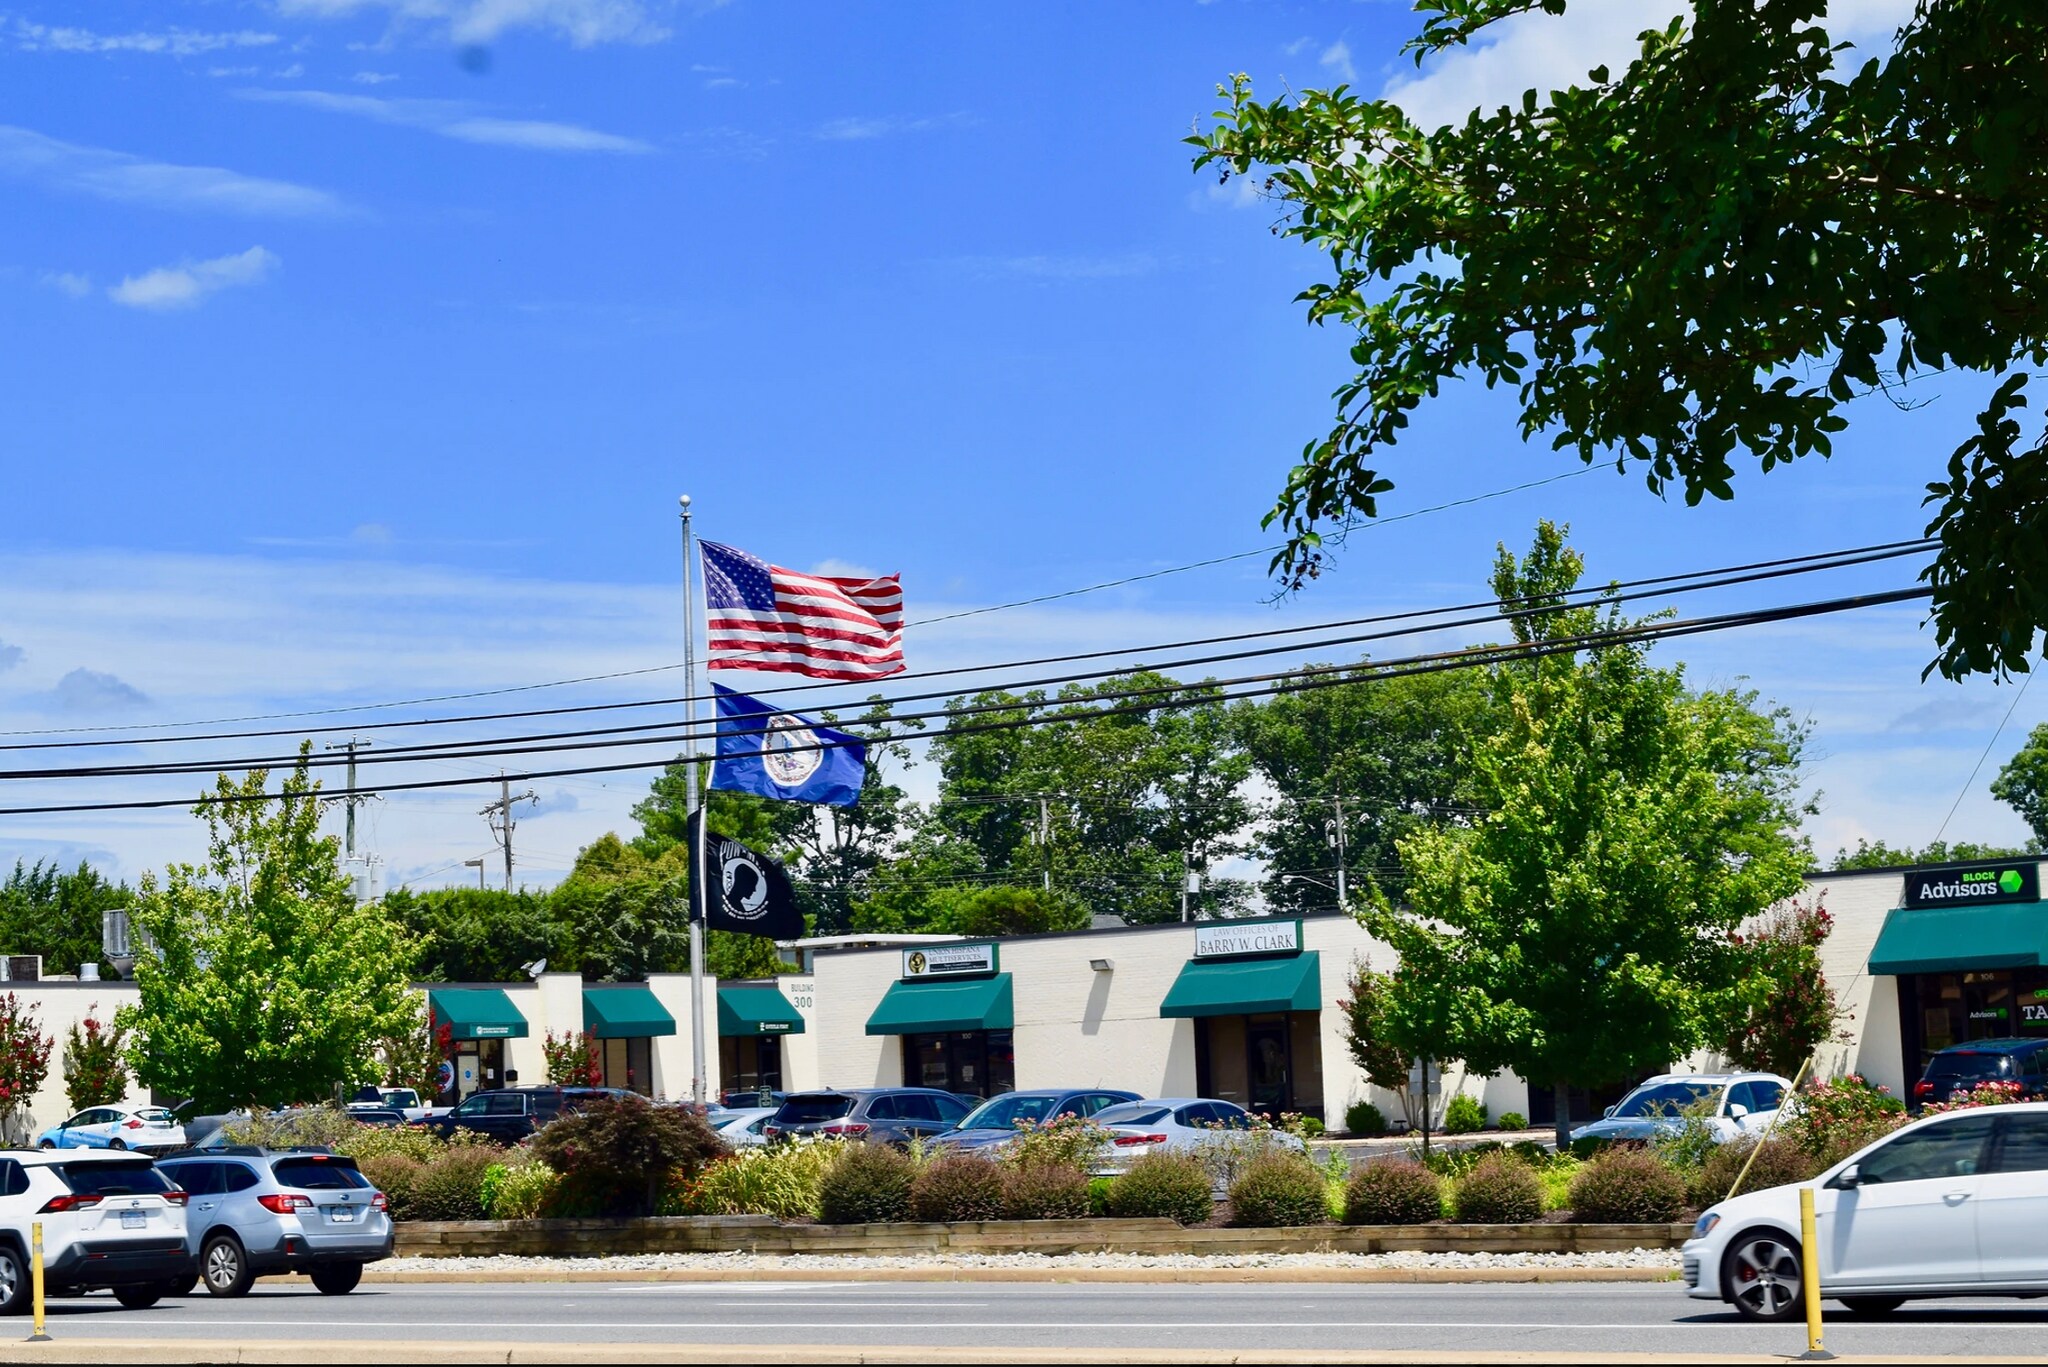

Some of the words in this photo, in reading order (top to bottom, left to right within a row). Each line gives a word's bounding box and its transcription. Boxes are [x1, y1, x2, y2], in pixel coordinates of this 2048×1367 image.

[1962, 872, 1996, 882] BLOCK
[1920, 881, 1998, 900] Advisors
[1213, 928, 1230, 937] LAW
[1232, 926, 1266, 935] OFFICES
[1268, 924, 1280, 933] OF
[1200, 938, 1236, 954] BARRY
[1238, 937, 1253, 951] W.
[1254, 934, 1294, 950] CLARK
[928, 948, 951, 956] UNION
[928, 953, 982, 964] MULTISERVICES
[791, 983, 814, 993] BUILDING
[794, 996, 813, 1008] 300
